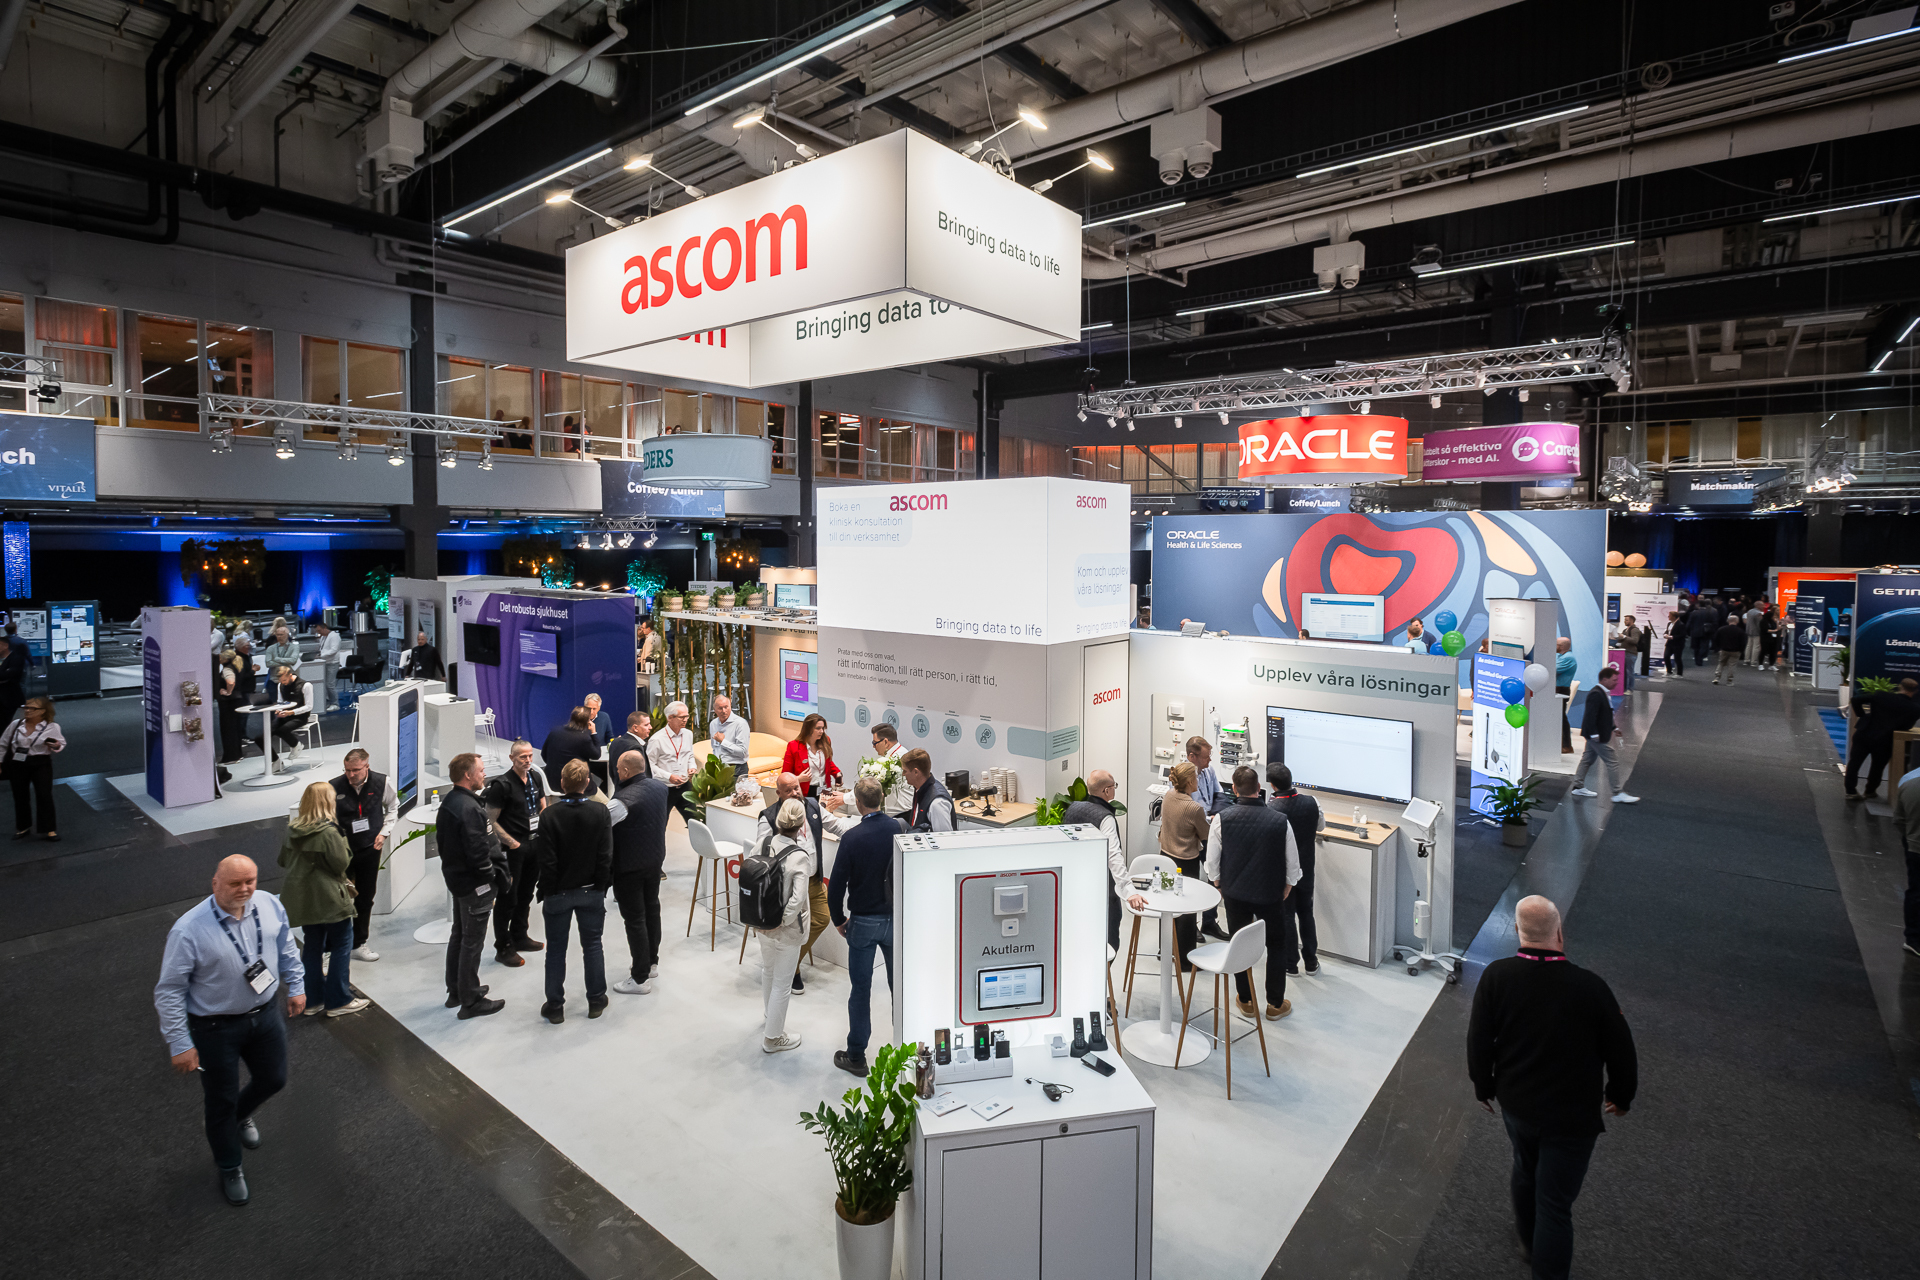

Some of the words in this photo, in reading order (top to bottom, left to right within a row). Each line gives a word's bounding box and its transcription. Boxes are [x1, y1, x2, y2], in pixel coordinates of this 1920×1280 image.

[938, 210, 996, 254] Bringing
[1000, 238, 1026, 262] data
[1030, 250, 1041, 268] to
[1044, 255, 1060, 276] life
[622, 204, 808, 314] ascom
[796, 311, 870, 340] Bringing
[878, 301, 922, 324] data
[1441, 444, 1450, 454] så
[1453, 442, 1502, 453] effektiva
[0, 448, 36, 465] ch
[644, 448, 674, 471] DERS
[1458, 455, 1482, 464] med
[1485, 454, 1499, 462] AI.
[48, 482, 86, 493] VITALIS
[829, 502, 848, 512] Boka
[890, 494, 948, 511] ascom
[1076, 495, 1107, 509] ascom
[1290, 500, 1340, 508] Coffee/Lunch
[829, 517, 852, 526] klinisk
[854, 517, 902, 526] konsultation
[829, 533, 838, 541] till
[840, 533, 851, 541] din
[853, 532, 900, 541] verksamhet
[1166, 531, 1220, 539] ORACLE
[1078, 566, 1092, 578] Kom
[1094, 566, 1106, 577] och
[1108, 566, 1129, 578] upplev
[1077, 583, 1092, 595] våra
[1094, 582, 1122, 595] lösningar
[500, 602, 511, 612] Det
[512, 604, 535, 616] robusta
[537, 606, 568, 619] sjukhuset
[936, 618, 979, 634] Bringing
[983, 622, 1006, 634] data
[1010, 624, 1021, 635] to
[1025, 624, 1042, 636] life
[1076, 623, 1099, 634] Bringing
[1101, 622, 1112, 631] data
[1113, 620, 1118, 629] to
[884, 653, 896, 662] vad,
[837, 658, 849, 668] rätt
[851, 660, 897, 675] information,
[898, 665, 908, 676] till
[910, 667, 923, 678] rätt
[925, 670, 958, 683] person,
[961, 672, 963, 682] i
[966, 674, 981, 684] rätt
[983, 675, 998, 687] tid,
[847, 672, 866, 681] innebära
[878, 676, 908, 687] verksamhet?
[1254, 664, 1312, 683] Upplev
[1317, 670, 1354, 687] våra
[1361, 674, 1450, 698] lösningar
[1093, 688, 1121, 705] ascom
[982, 944, 1035, 956] Akutlarm
